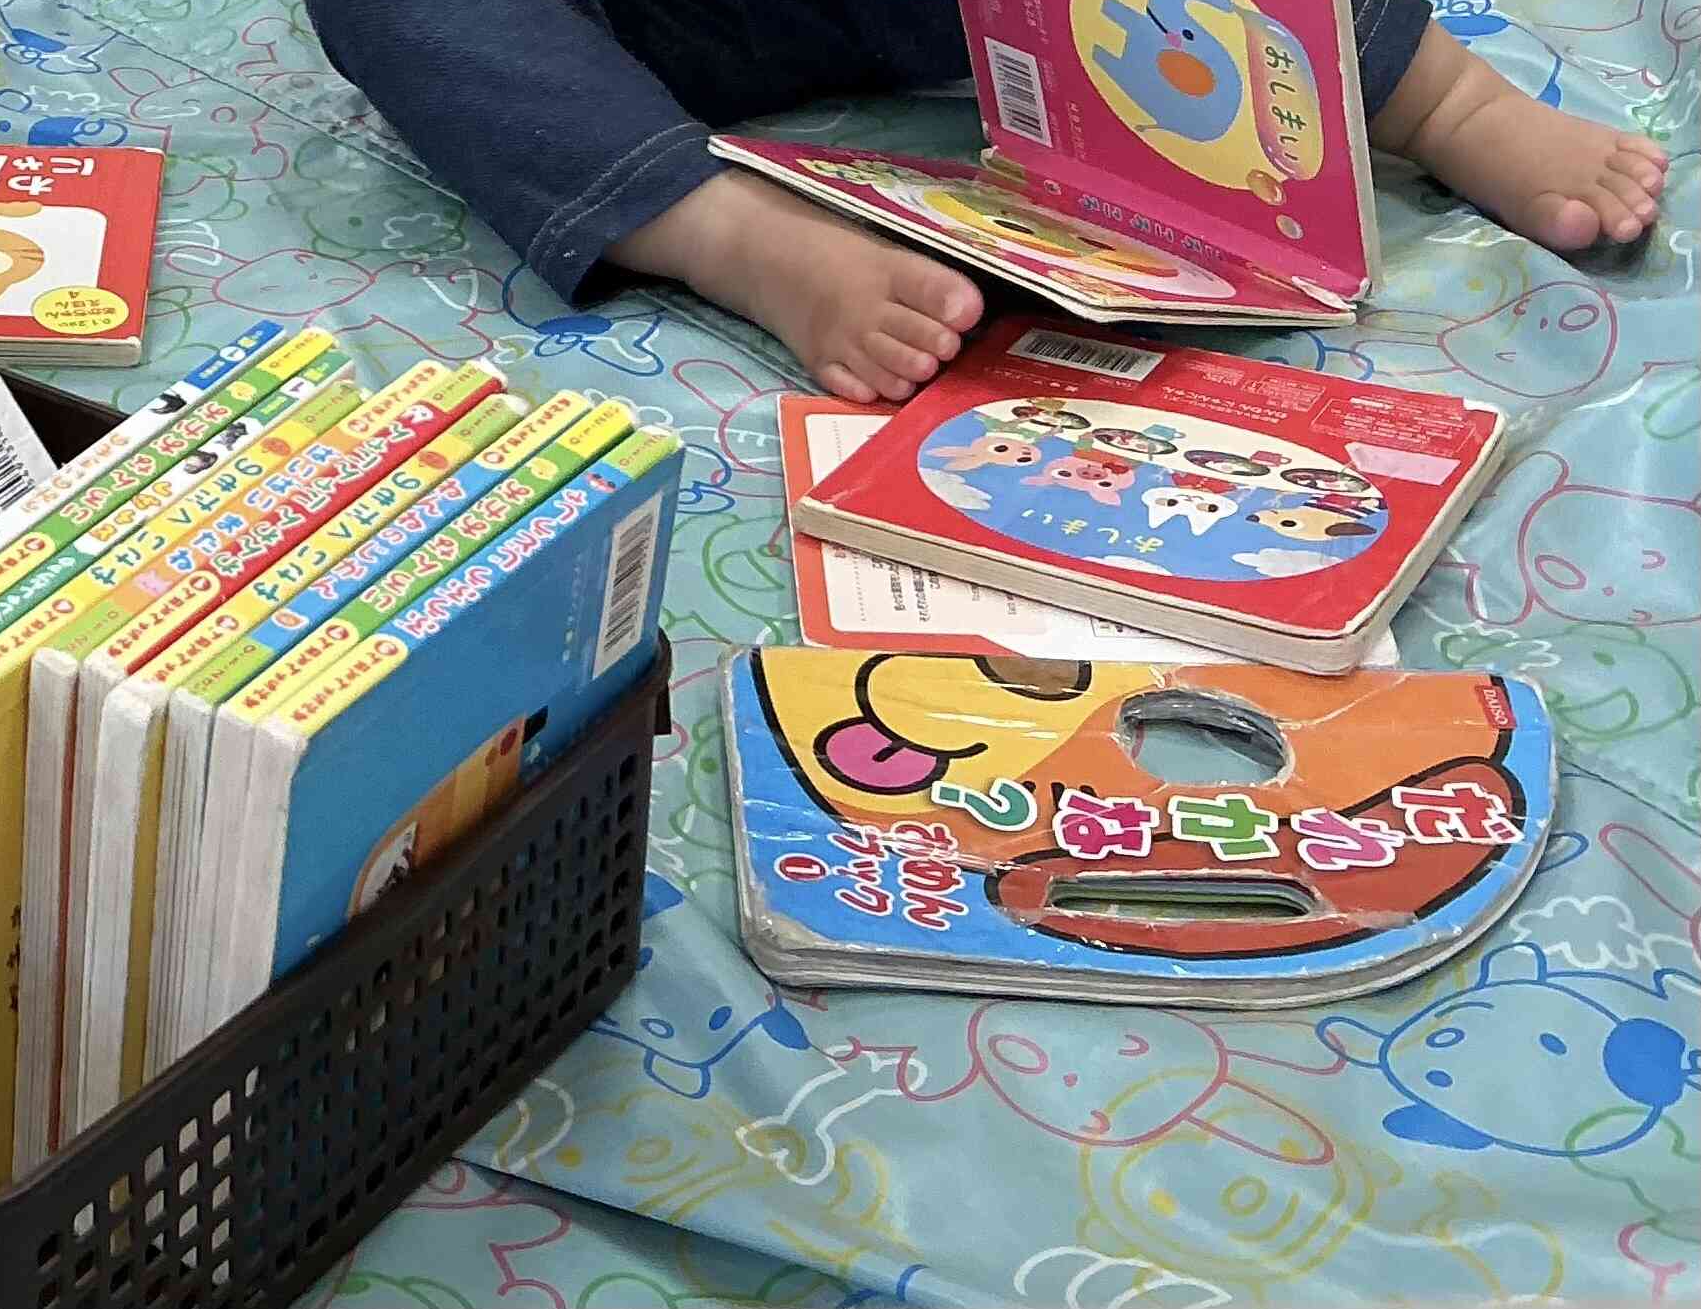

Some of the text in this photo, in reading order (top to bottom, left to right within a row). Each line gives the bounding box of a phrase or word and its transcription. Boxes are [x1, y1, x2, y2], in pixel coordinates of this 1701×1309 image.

[1263, 44, 1308, 163] おしまい
[55, 298, 101, 309] えほん
[60, 399, 233, 524] いろんな おかお
[90, 480, 173, 541] どうぶつ
[206, 419, 415, 577] わんわん にゃんにゃん
[90, 458, 264, 586] やさい くだもの
[253, 464, 422, 604] やさい くだもの
[357, 478, 535, 614] いろんな おかお
[394, 488, 589, 640] ぶうぶう じどうしゃ
[1021, 508, 1165, 554] おしまい
[1483, 688, 1510, 726] DAISO
[827, 822, 894, 917] ブック
[893, 820, 970, 932] おめん
